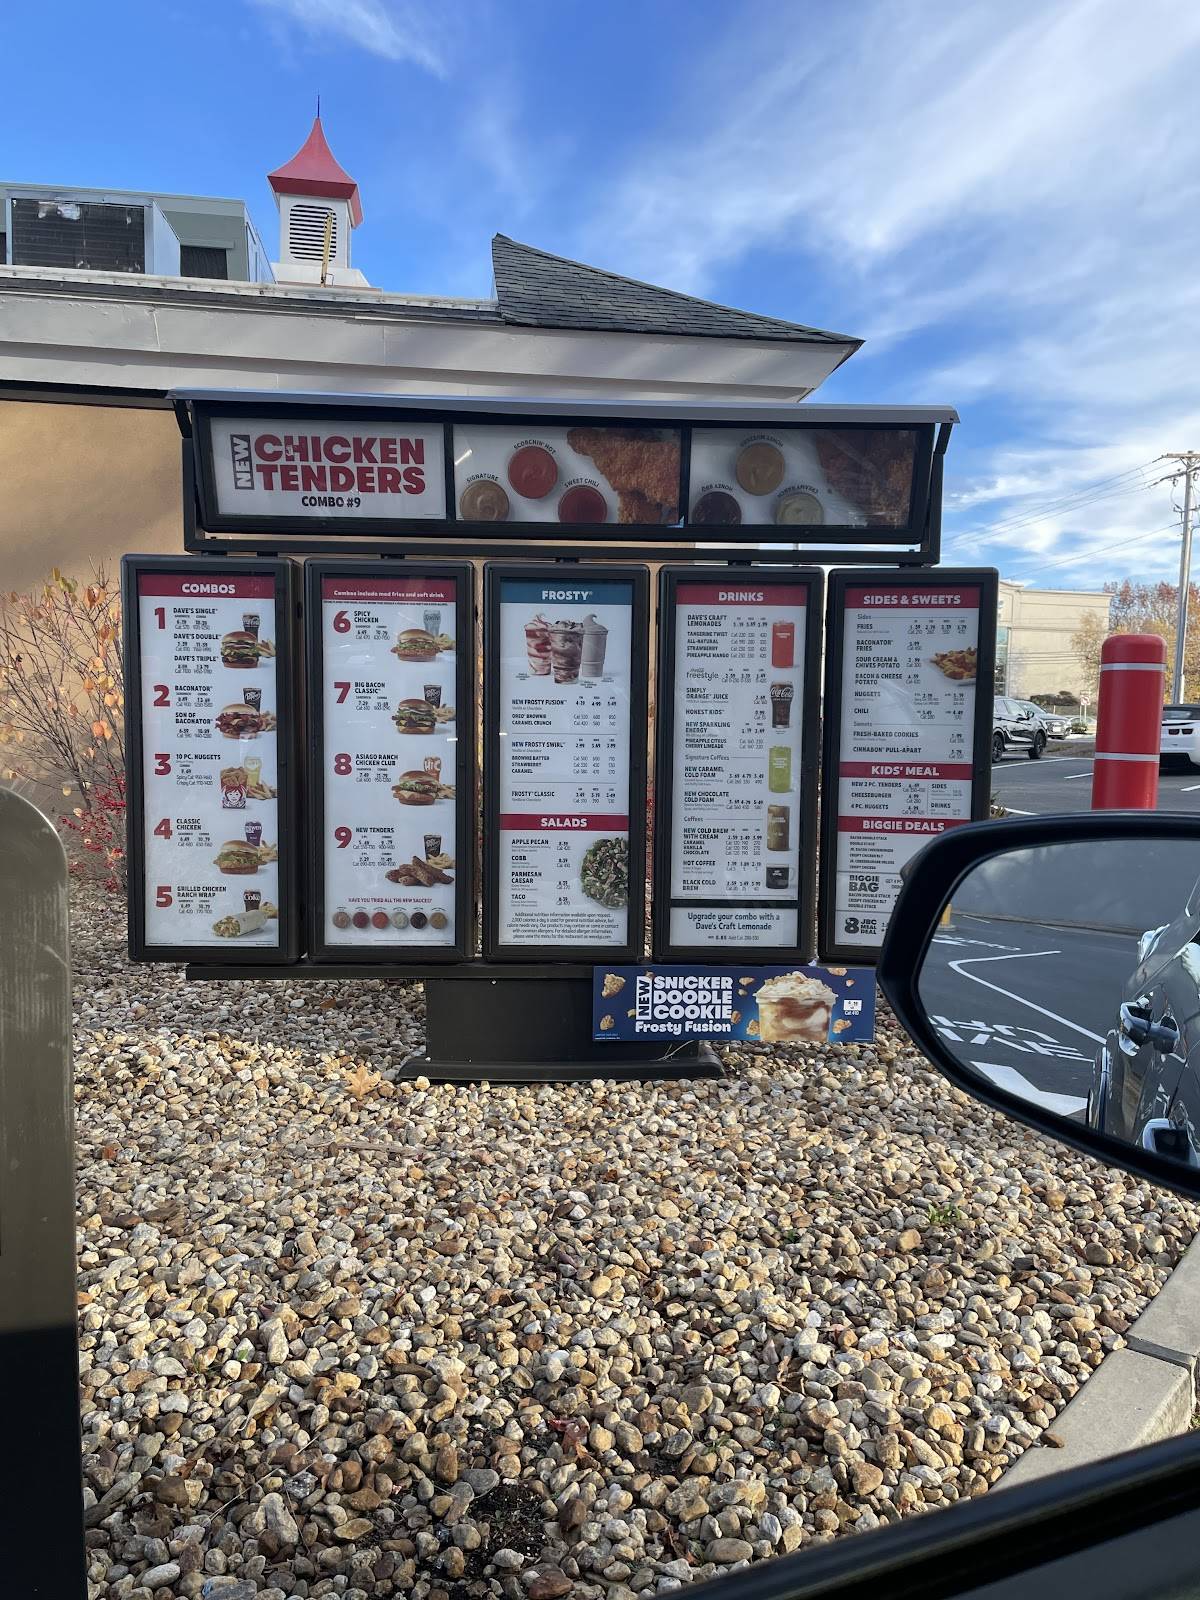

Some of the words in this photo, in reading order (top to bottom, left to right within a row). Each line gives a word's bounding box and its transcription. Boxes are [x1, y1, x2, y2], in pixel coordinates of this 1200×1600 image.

[254, 434, 425, 464] CHICKEN
[544, 443, 556, 455] HOT
[230, 434, 254, 490] NEW
[256, 464, 426, 494] TENDERS
[466, 473, 499, 483] SIGNATURE
[564, 478, 583, 488] SWEET
[584, 478, 600, 487] CHILI
[301, 496, 344, 507] COMBO
[346, 498, 361, 507] #9
[182, 583, 235, 594] COMBOS
[542, 591, 589, 600] FROSTY
[719, 592, 764, 601] DRINKS
[864, 595, 898, 604] SIDES
[901, 595, 909, 604] &
[911, 595, 961, 604] SWEETS
[155, 607, 165, 629] 1
[333, 610, 351, 633] 6
[686, 672, 718, 681] freestyle
[153, 685, 170, 707] 2
[334, 682, 351, 703] 7
[155, 754, 171, 775] 3
[334, 753, 352, 775] 8
[871, 766, 903, 775] KIDS'
[906, 766, 939, 776] MEAL
[154, 818, 172, 840] 4
[541, 818, 587, 827] SALADS
[863, 820, 902, 830] BIGGIE
[905, 821, 945, 831] DEALS
[334, 826, 352, 848] 9
[849, 882, 879, 892] BAG
[156, 886, 172, 908] 5
[688, 912, 716, 922] Upgrade
[718, 914, 733, 922] your
[654, 975, 733, 990] SNICKER
[636, 976, 652, 1020] NEW
[654, 990, 732, 1004] DOODLE
[654, 1005, 732, 1019] COOKIE
[635, 1021, 682, 1036] Frosty
[686, 1020, 731, 1033] Fusion
